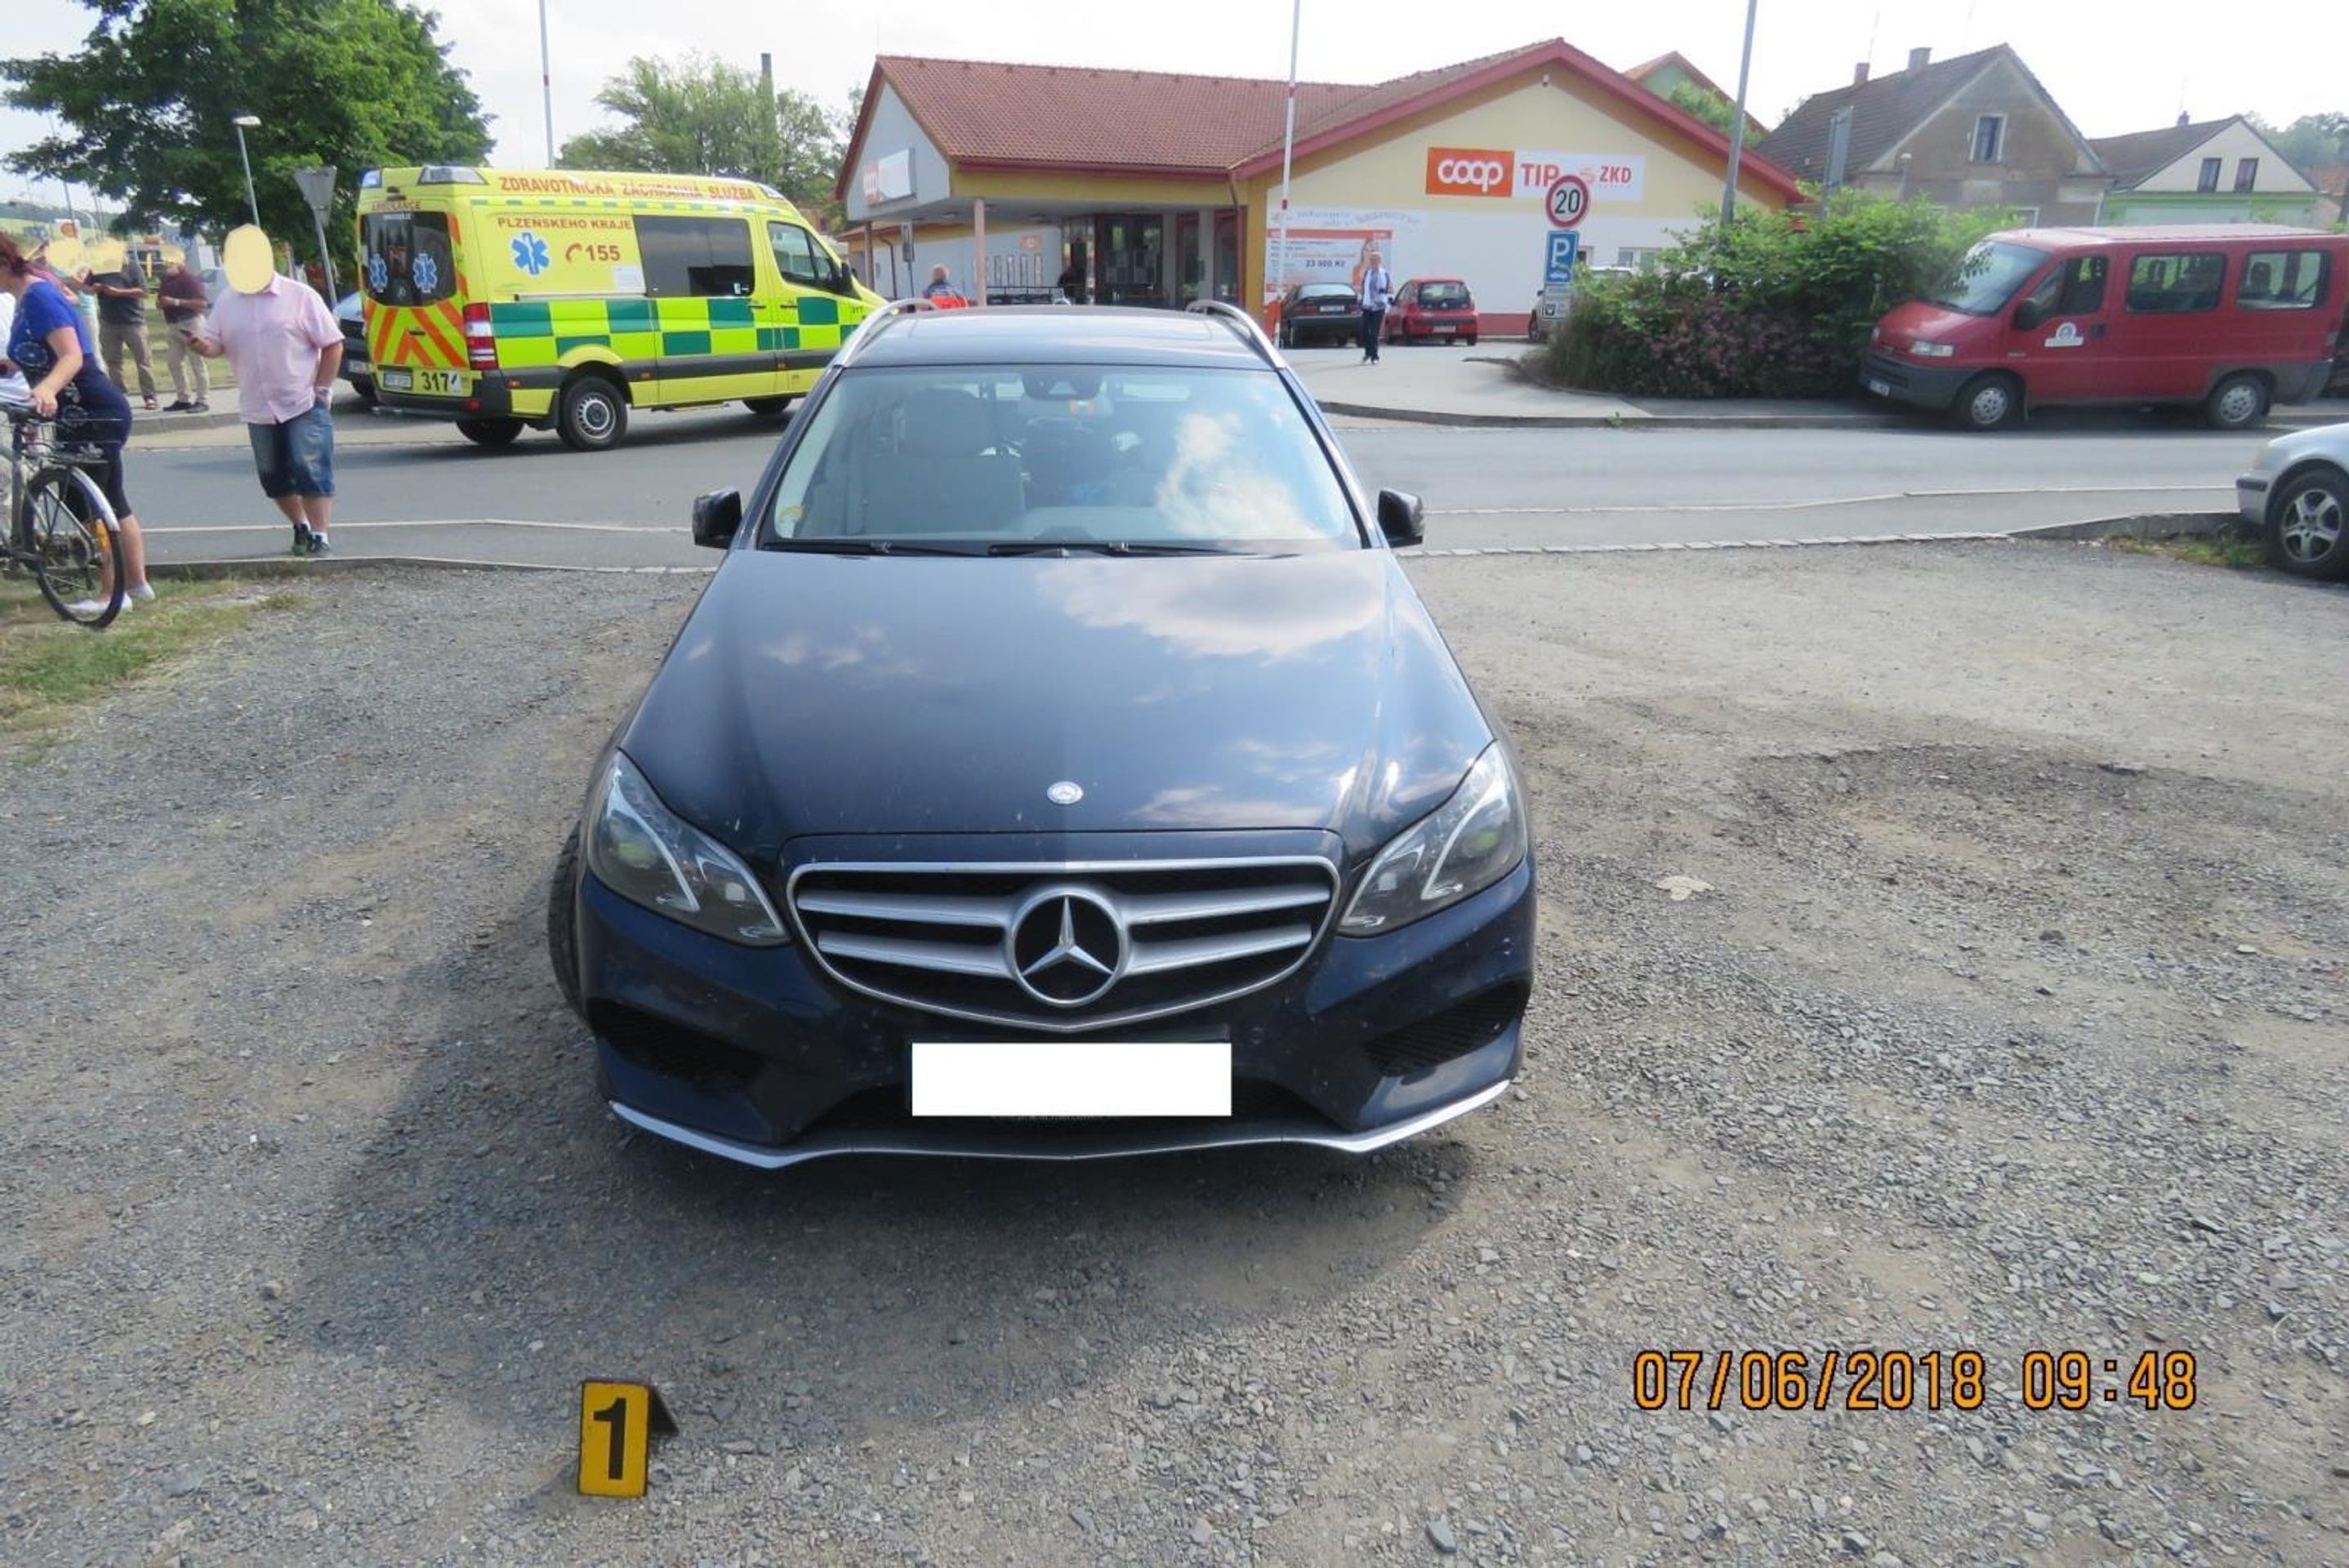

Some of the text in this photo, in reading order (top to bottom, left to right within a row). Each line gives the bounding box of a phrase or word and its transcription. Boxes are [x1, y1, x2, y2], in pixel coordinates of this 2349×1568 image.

[1437, 158, 1504, 194] coop
[1521, 163, 1632, 187] TIP ZKD
[1554, 188, 1581, 215] 20
[590, 219, 633, 230] KRAJE
[585, 244, 622, 262] 155
[421, 371, 449, 393] 317
[593, 1397, 626, 1480] 1
